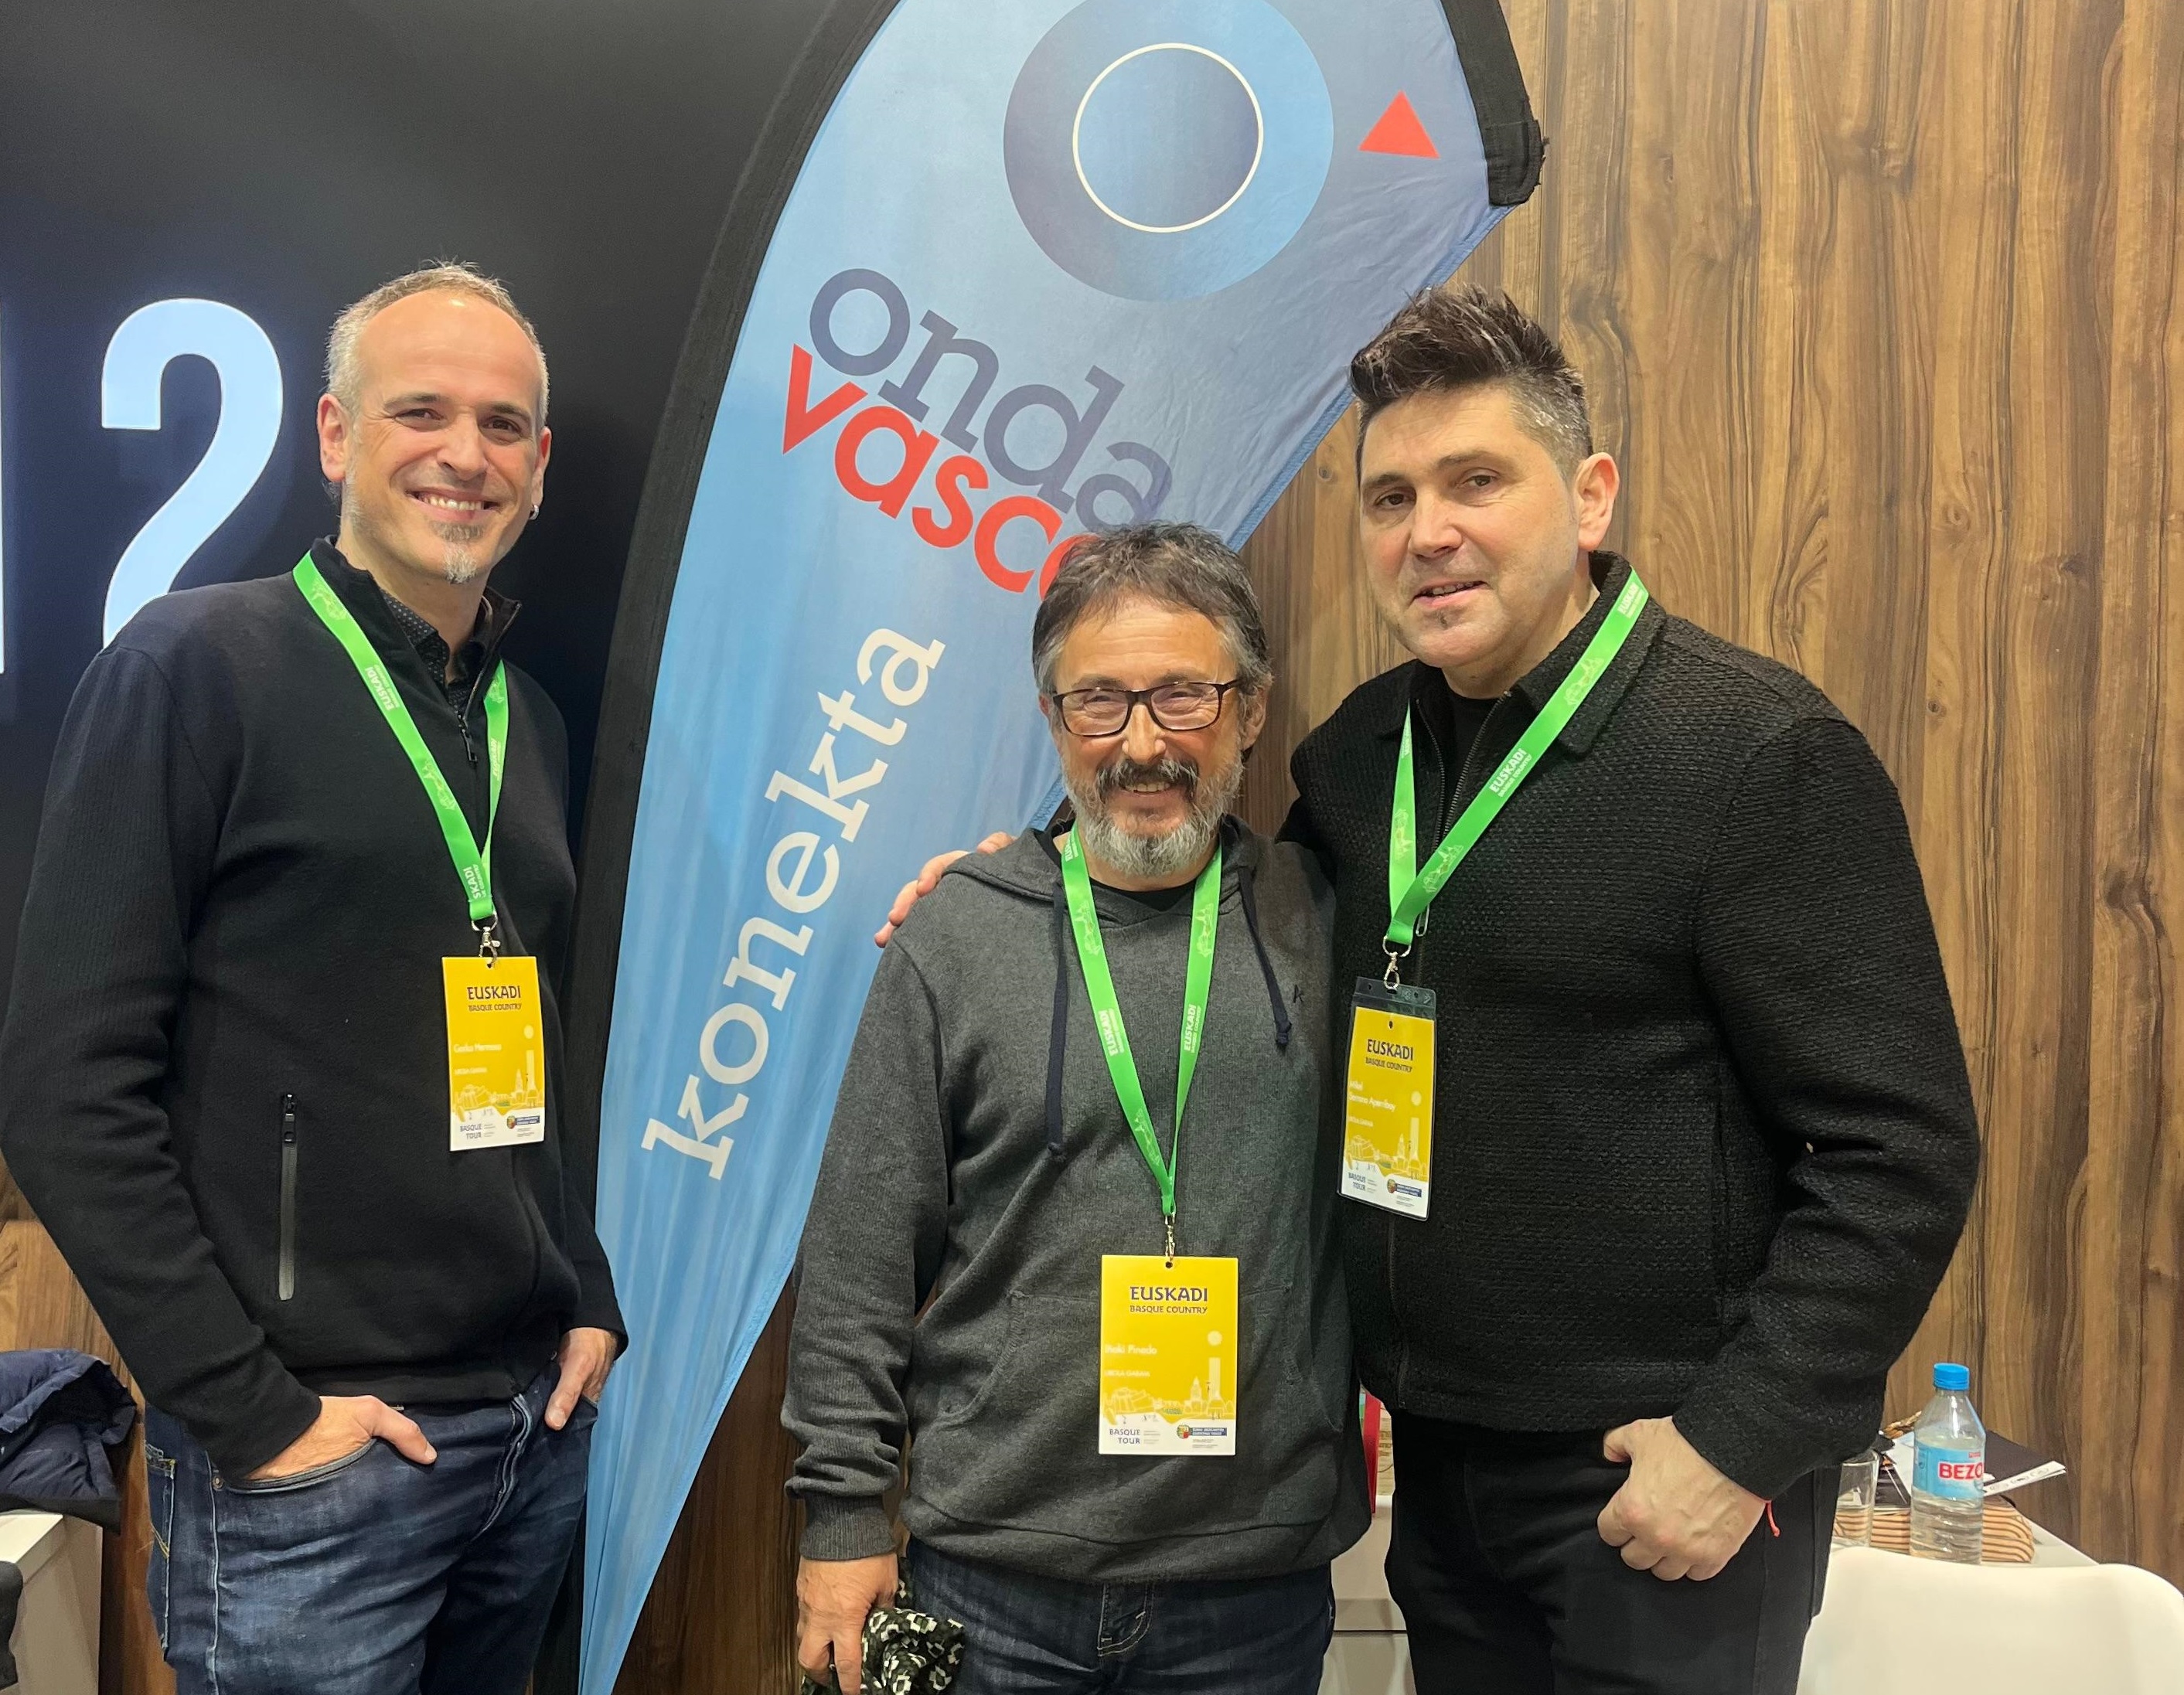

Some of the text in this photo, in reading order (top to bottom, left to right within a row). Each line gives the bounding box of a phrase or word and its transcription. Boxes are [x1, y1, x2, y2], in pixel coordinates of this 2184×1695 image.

[809, 267, 1173, 533] onda
[782, 342, 1099, 601] vasc
[365, 666, 397, 711] EUSKADI
[1489, 747, 1528, 794] EUSKADI
[640, 627, 947, 1180] konekta
[466, 985, 522, 1001] EUSKADI
[494, 1002, 522, 1011] COUNTRY
[1184, 1004, 1197, 1051] EUSKADI
[1366, 1038, 1414, 1061] EUSKADI
[466, 1132, 482, 1140] TOUR
[1129, 1286, 1208, 1302] EUSKADI
[1129, 1305, 1208, 1315] BASQUE COUNTRY
